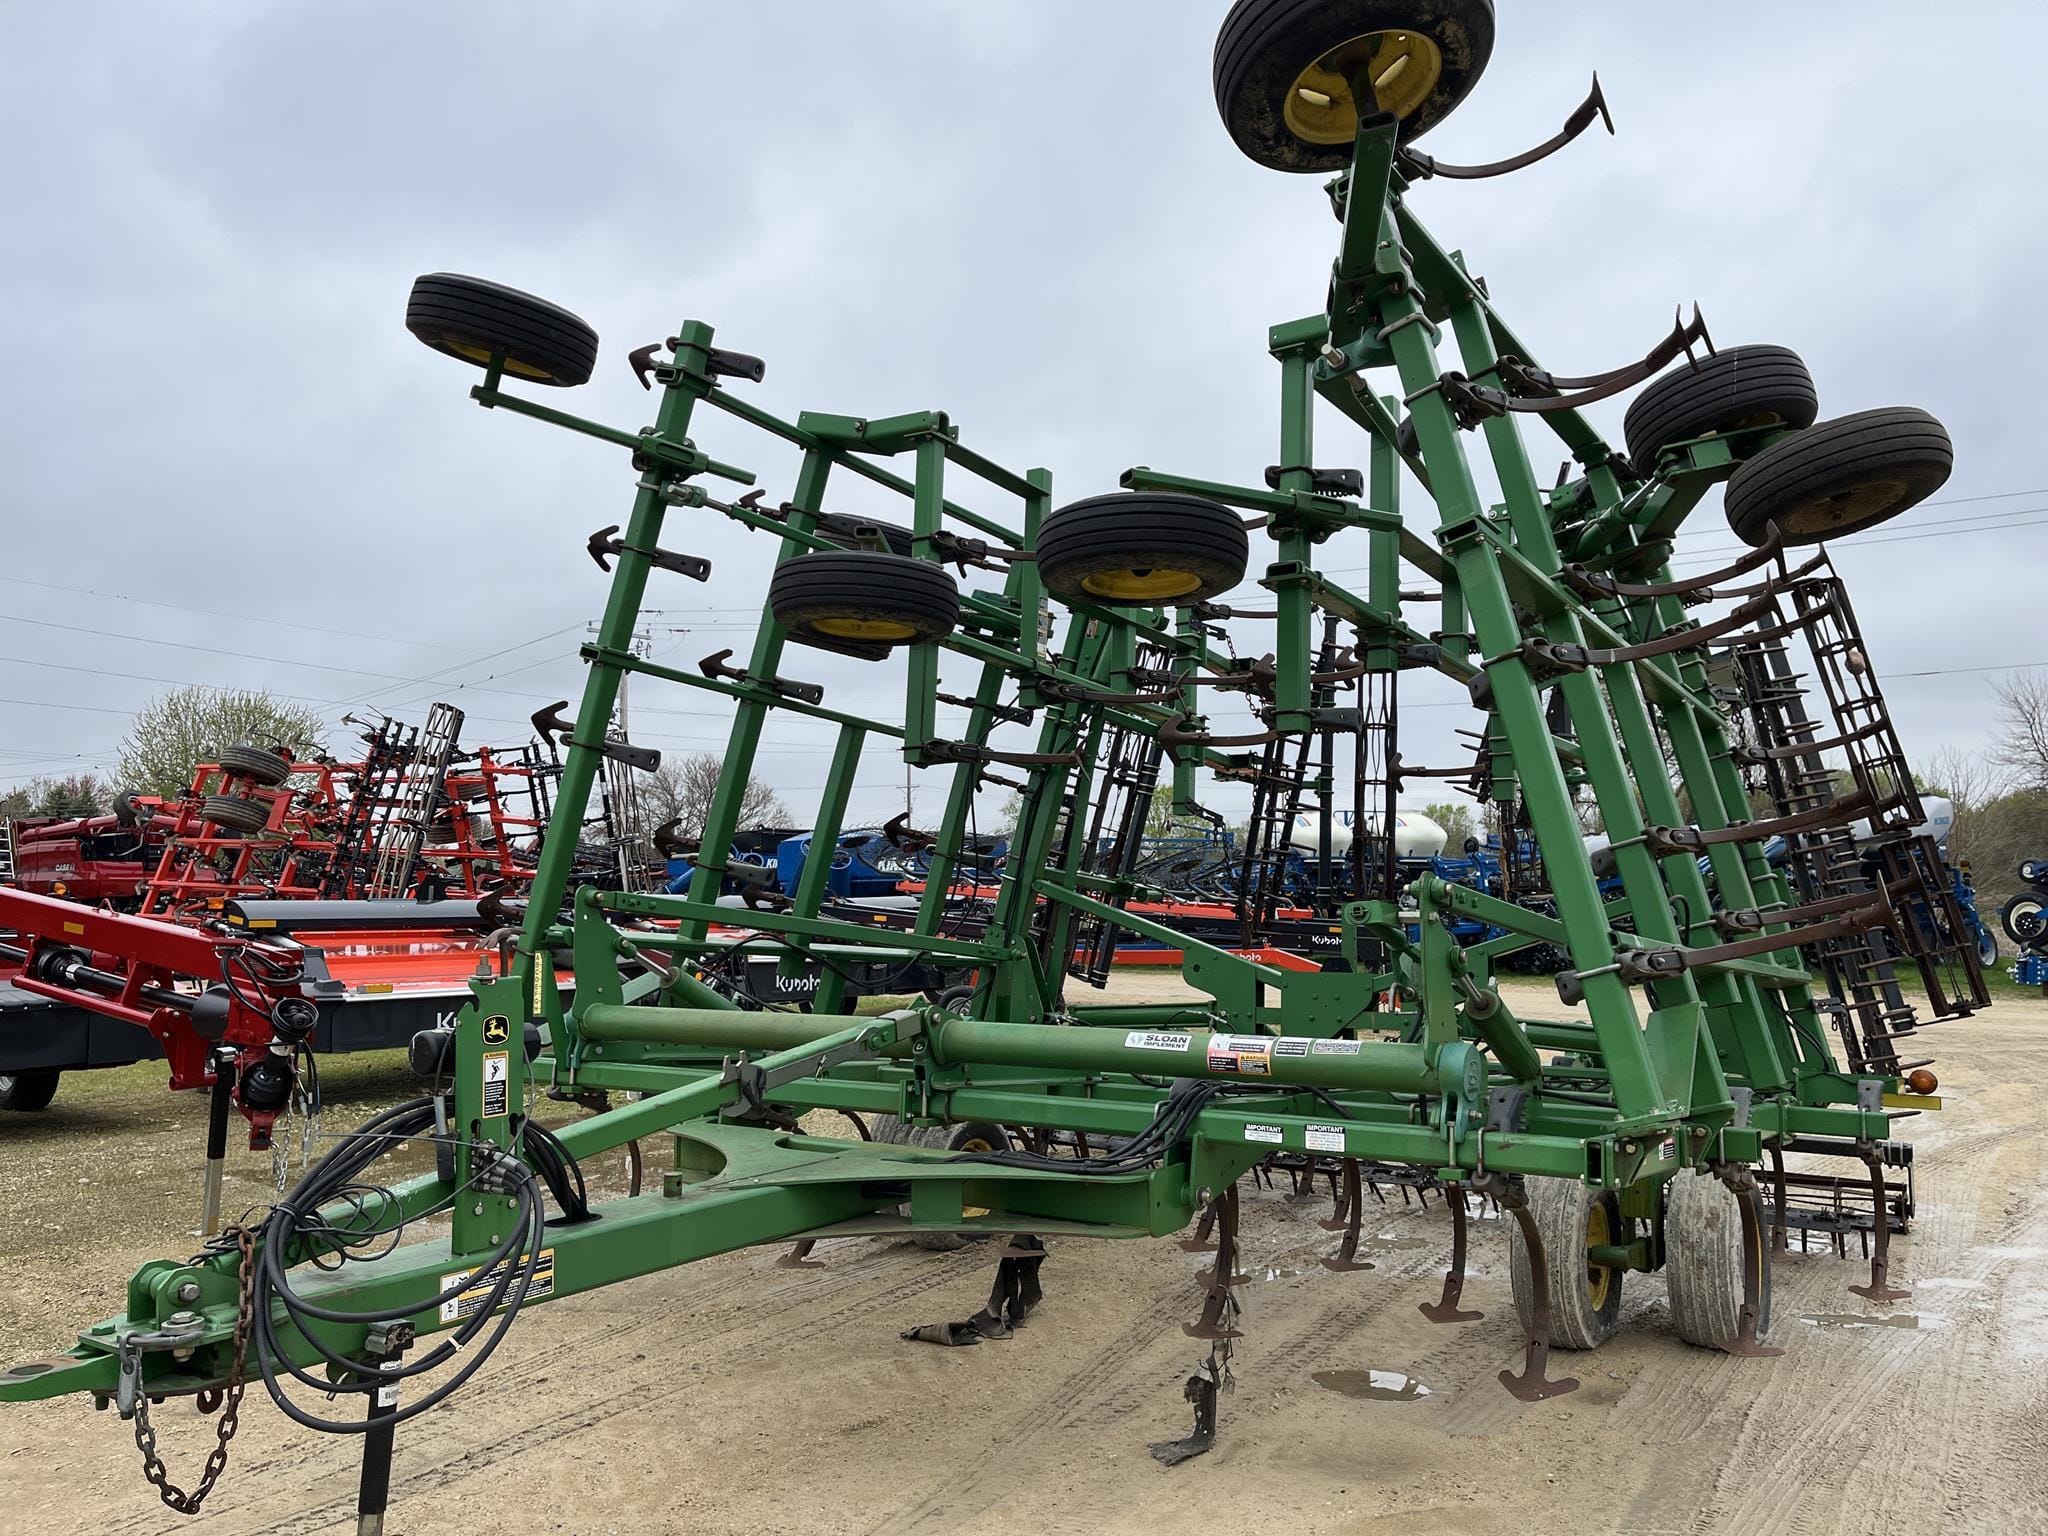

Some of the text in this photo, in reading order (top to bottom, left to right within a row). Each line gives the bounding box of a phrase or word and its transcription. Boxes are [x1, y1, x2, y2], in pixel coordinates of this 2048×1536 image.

[1146, 1034, 1188, 1043] SLOAN
[1144, 1041, 1187, 1049] IMPLEMENT
[1246, 1124, 1281, 1133] IMPORTANT
[1306, 1125, 1344, 1133] IMPORTANT
